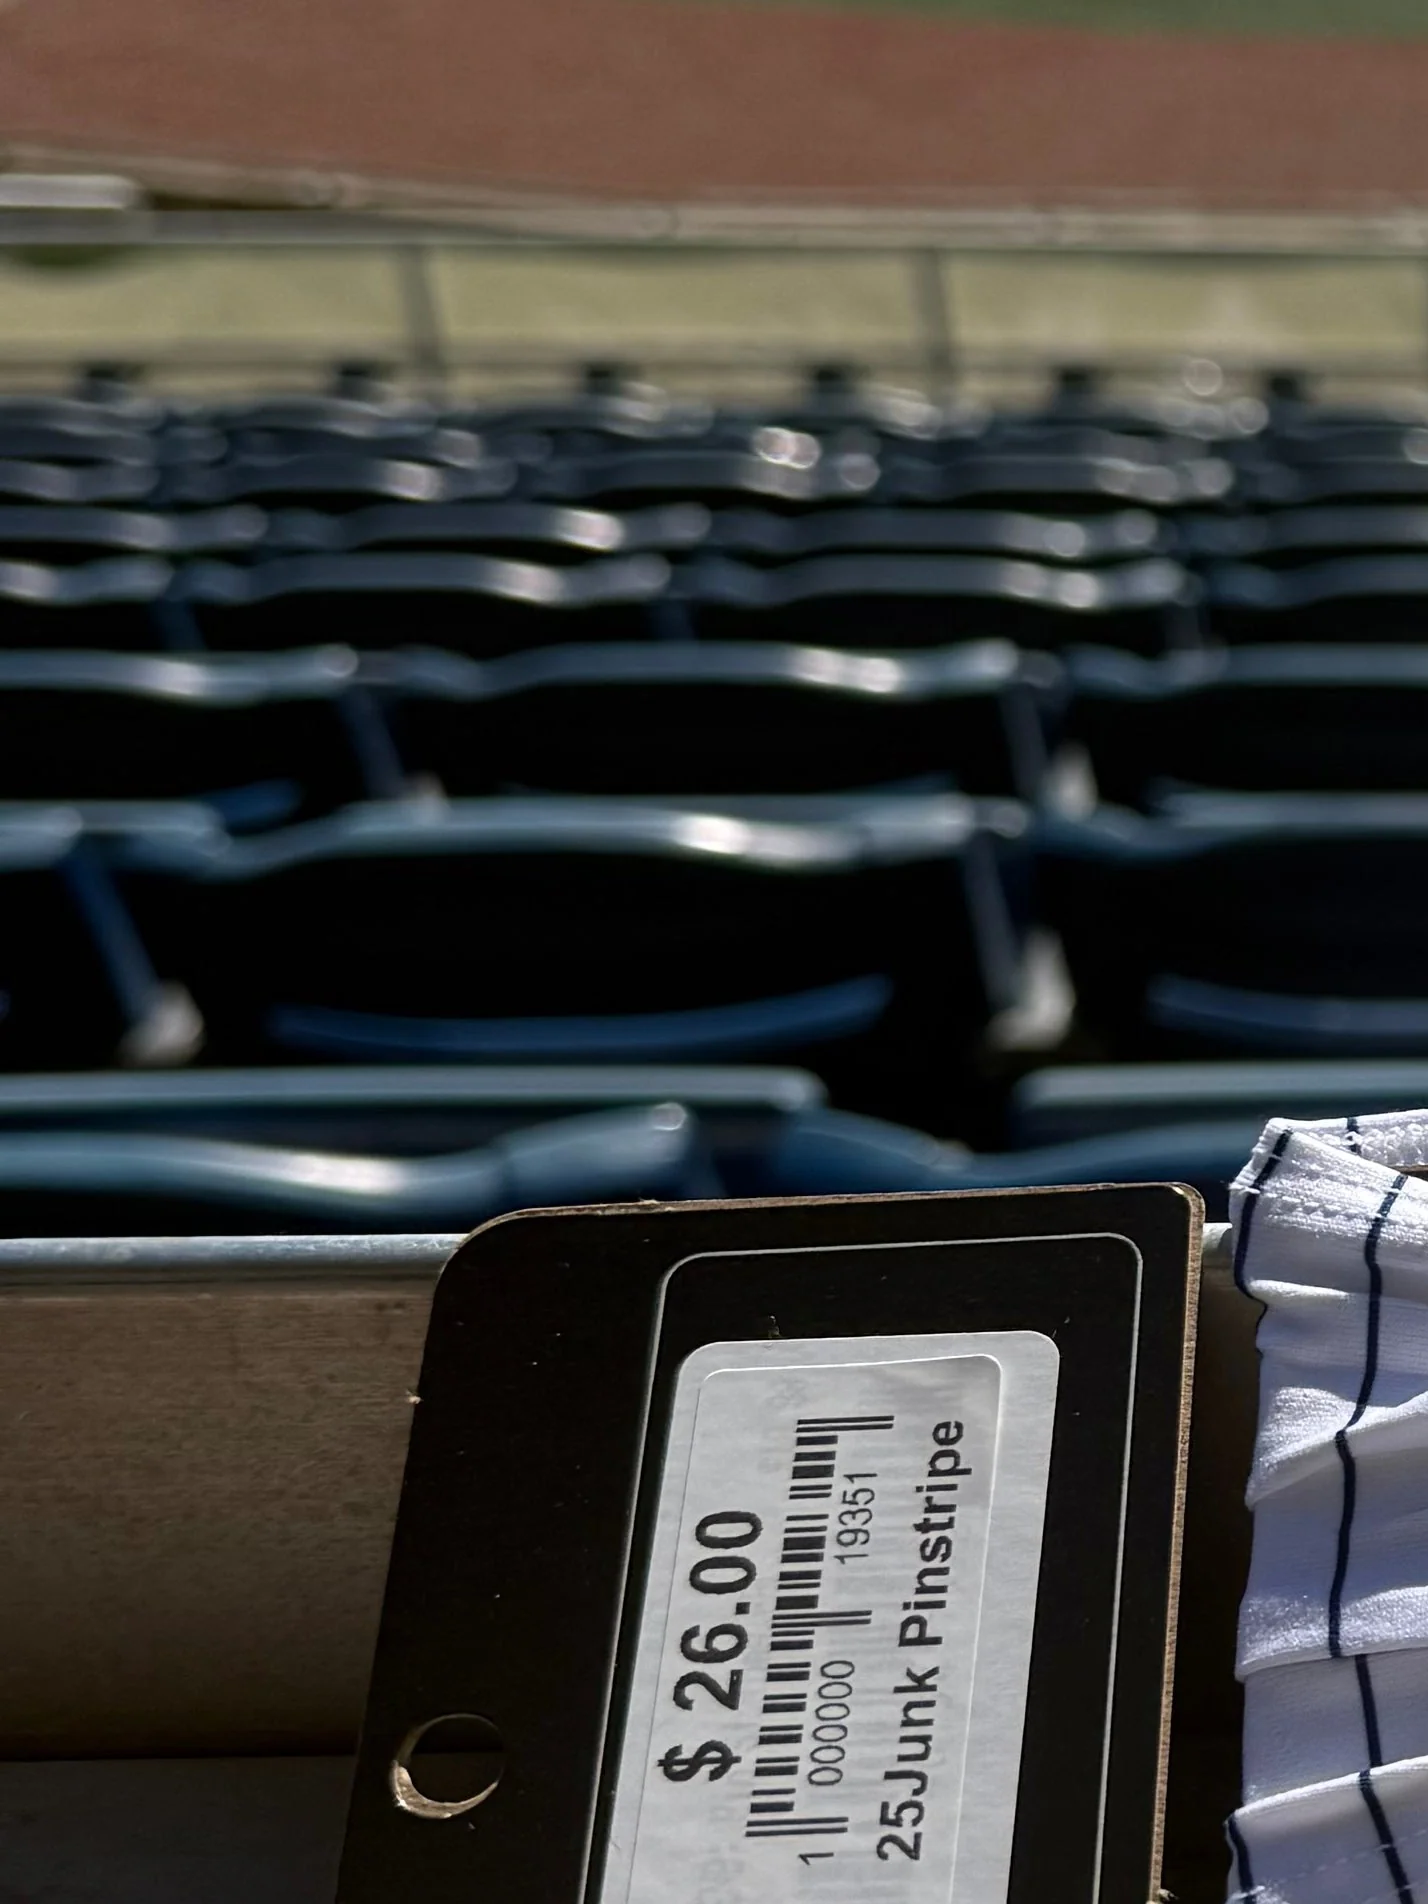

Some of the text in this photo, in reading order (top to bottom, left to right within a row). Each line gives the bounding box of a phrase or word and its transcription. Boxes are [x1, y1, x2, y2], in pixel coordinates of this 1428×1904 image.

[657, 1737, 743, 1783] $
[672, 1509, 764, 1713] 26.00
[797, 1470, 879, 1866] 1 000000 19351
[876, 1419, 973, 1862] 25Junk Pinstripe
